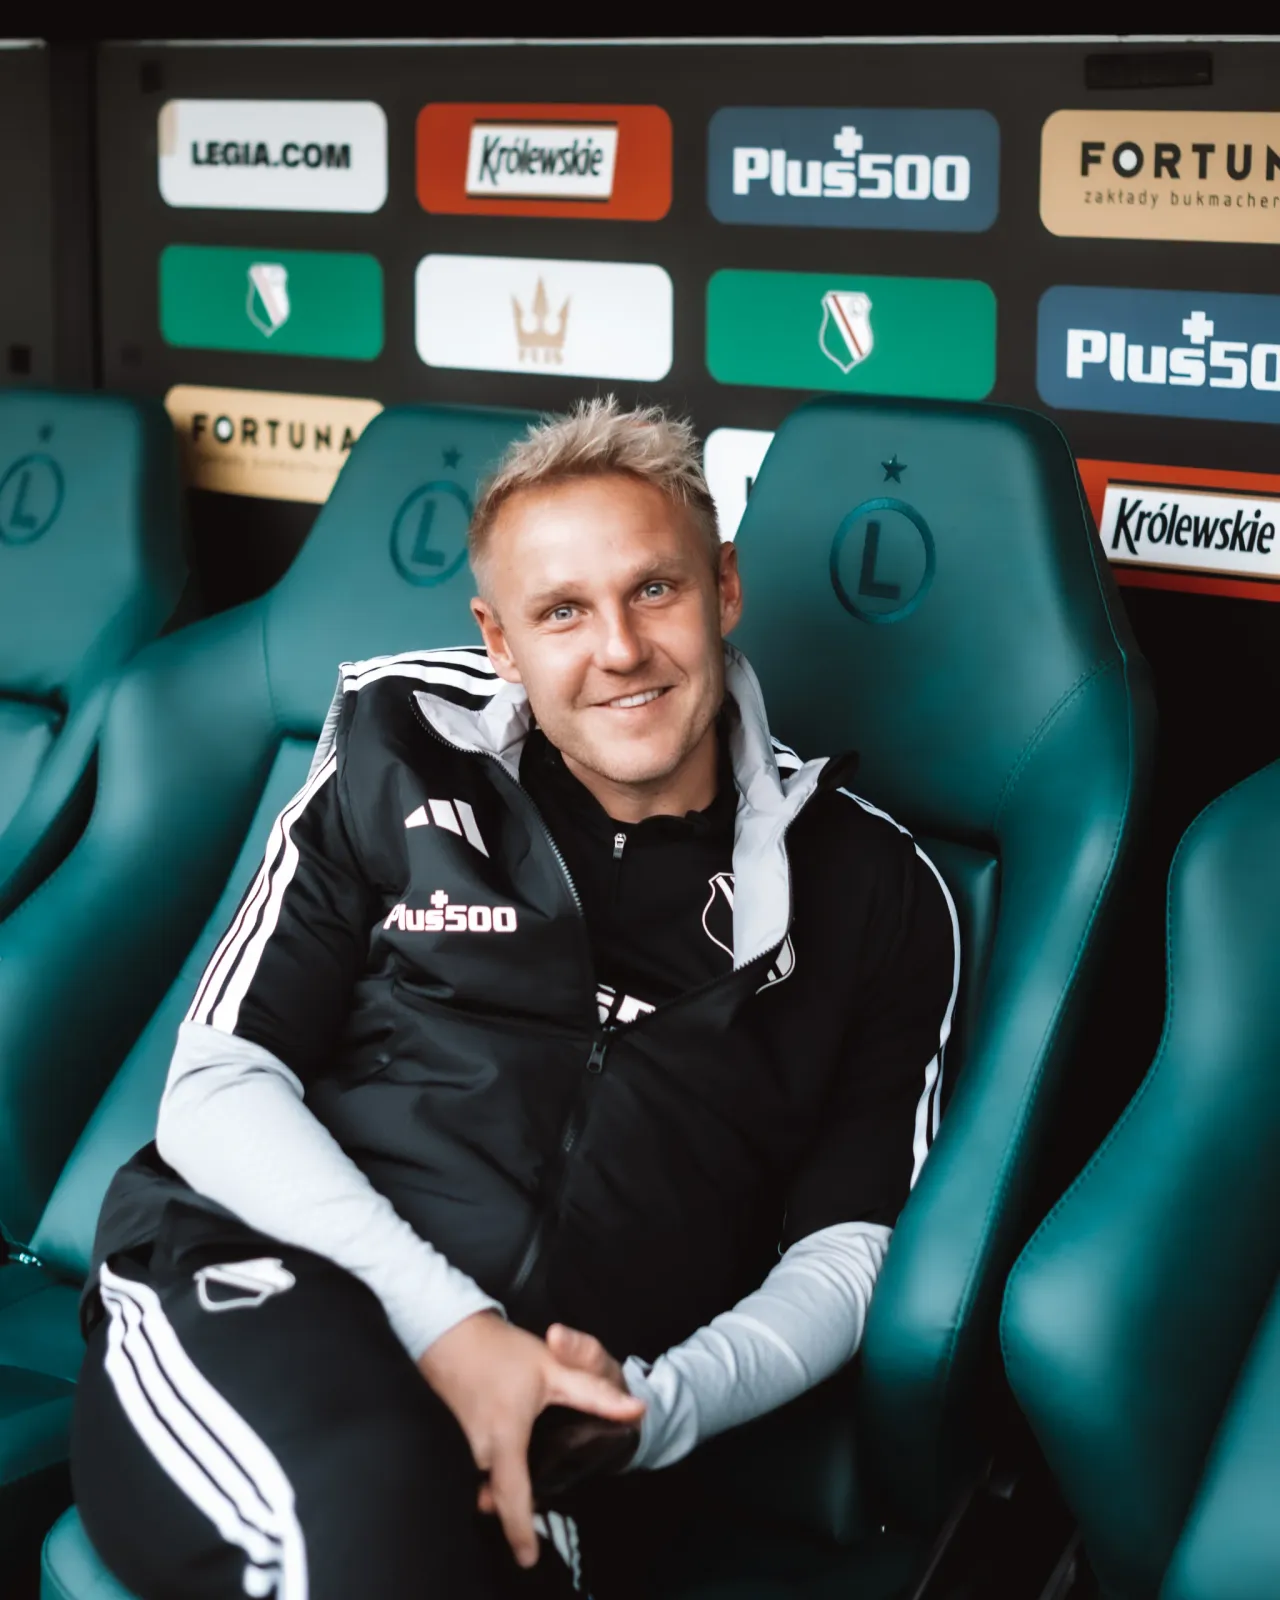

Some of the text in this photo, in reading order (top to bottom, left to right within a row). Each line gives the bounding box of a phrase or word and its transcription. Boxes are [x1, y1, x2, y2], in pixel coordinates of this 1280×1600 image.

[191, 140, 351, 169] LEGIA.COM
[479, 135, 604, 186] Królewskie
[733, 127, 970, 201] Plus500
[1084, 190, 1159, 209] zakłady
[192, 414, 357, 455] FORTUNA
[1111, 497, 1275, 556] Królewskie
